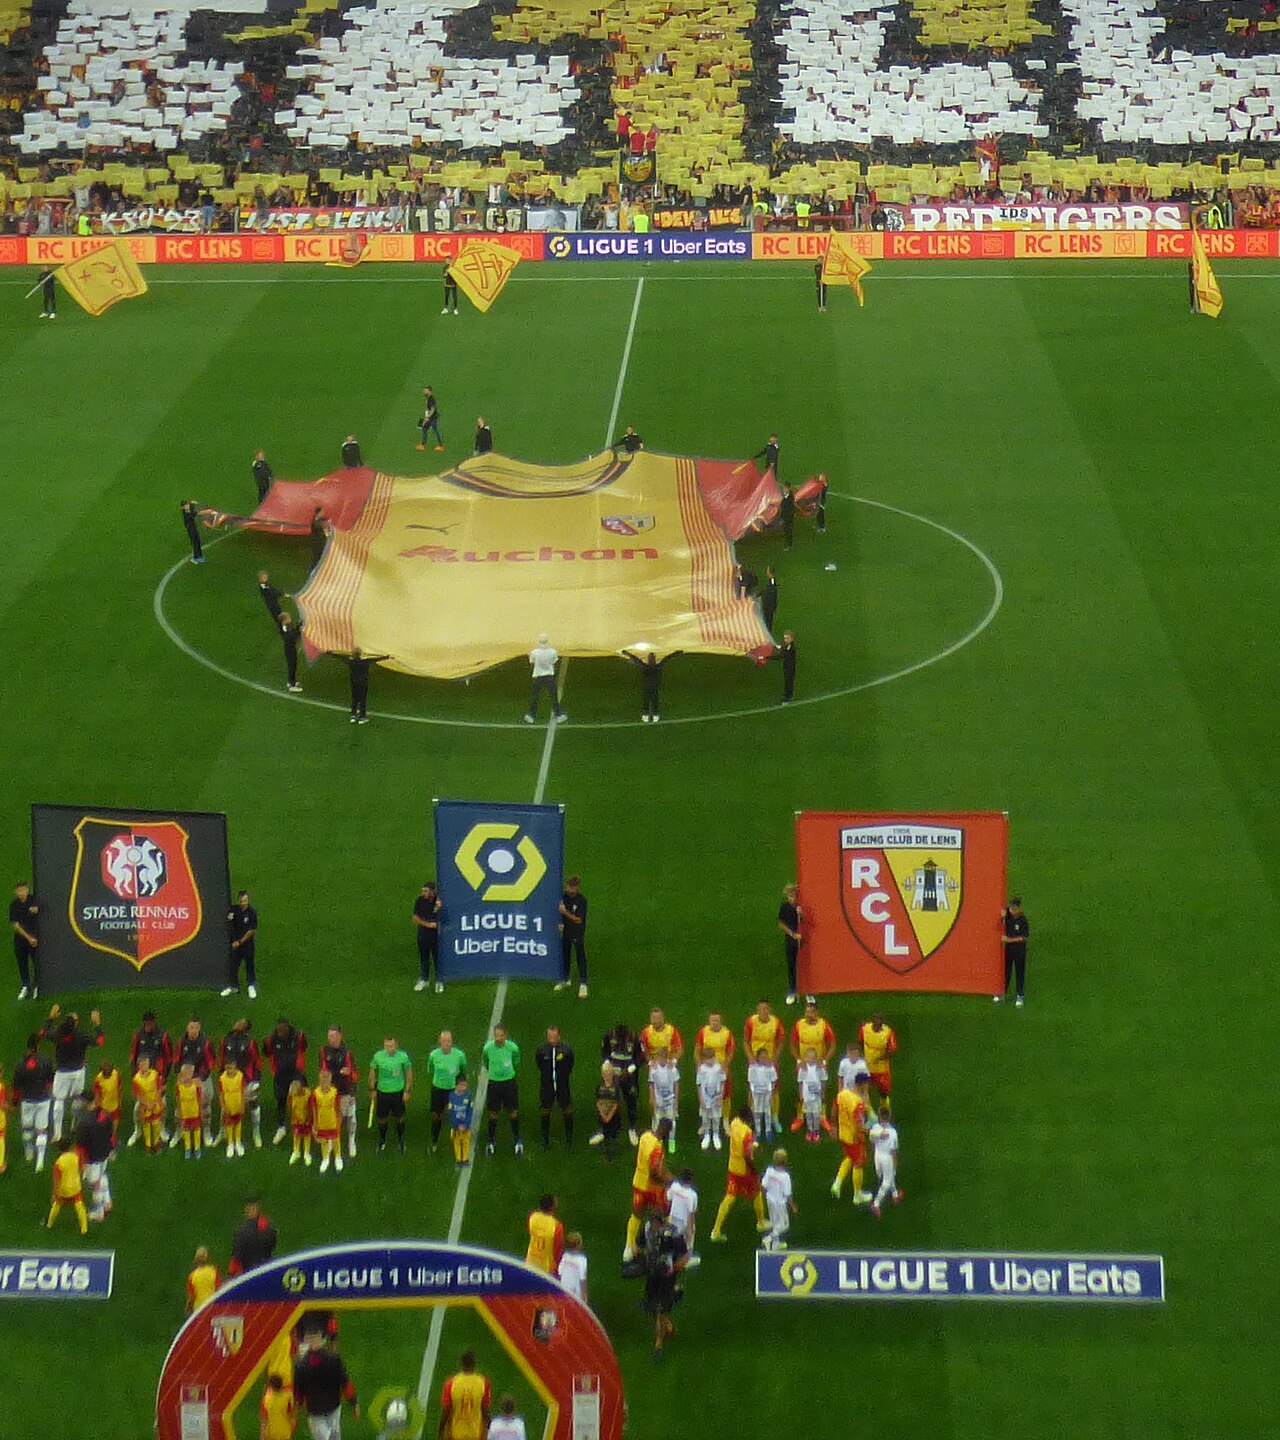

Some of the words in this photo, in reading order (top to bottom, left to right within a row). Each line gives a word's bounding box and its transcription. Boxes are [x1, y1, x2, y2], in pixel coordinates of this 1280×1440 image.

[37, 242, 64, 259] RC
[165, 240, 192, 260] RC
[200, 240, 243, 260] LENS
[424, 238, 451, 257] RC
[576, 238, 639, 256] LIGUE
[643, 238, 653, 255] 1
[660, 238, 702, 256] Uber
[704, 237, 747, 255] Eats
[762, 237, 789, 255] RC
[797, 237, 828, 255] LEN
[893, 236, 920, 255] RC
[927, 236, 972, 255] LENS
[1025, 234, 1052, 254] RC
[1060, 234, 1103, 254] LENS
[1157, 234, 1184, 253] RC
[1192, 234, 1236, 253] ENS
[398, 544, 660, 564] Auchan
[846, 835, 884, 845] RACING
[886, 835, 913, 845] CLUB
[915, 835, 929, 845] DE
[930, 835, 957, 845] LENS
[82, 906, 128, 920] STADE
[130, 906, 190, 920] RENNAIS
[460, 913, 528, 932] LIGUE
[533, 916, 543, 932] 1
[100, 921, 147, 930] FOOTBALL
[454, 938, 500, 955] Uber
[503, 936, 548, 956] Eats
[18, 1259, 91, 1291] Eats
[313, 1267, 384, 1289] LIGUE
[389, 1268, 399, 1287] 1
[408, 1266, 452, 1288] Uber
[456, 1265, 504, 1286] Eats
[837, 1259, 949, 1291] LIGUE
[959, 1261, 974, 1291] 1
[988, 1261, 1060, 1293] Uber
[1068, 1262, 1142, 1295] Eats
